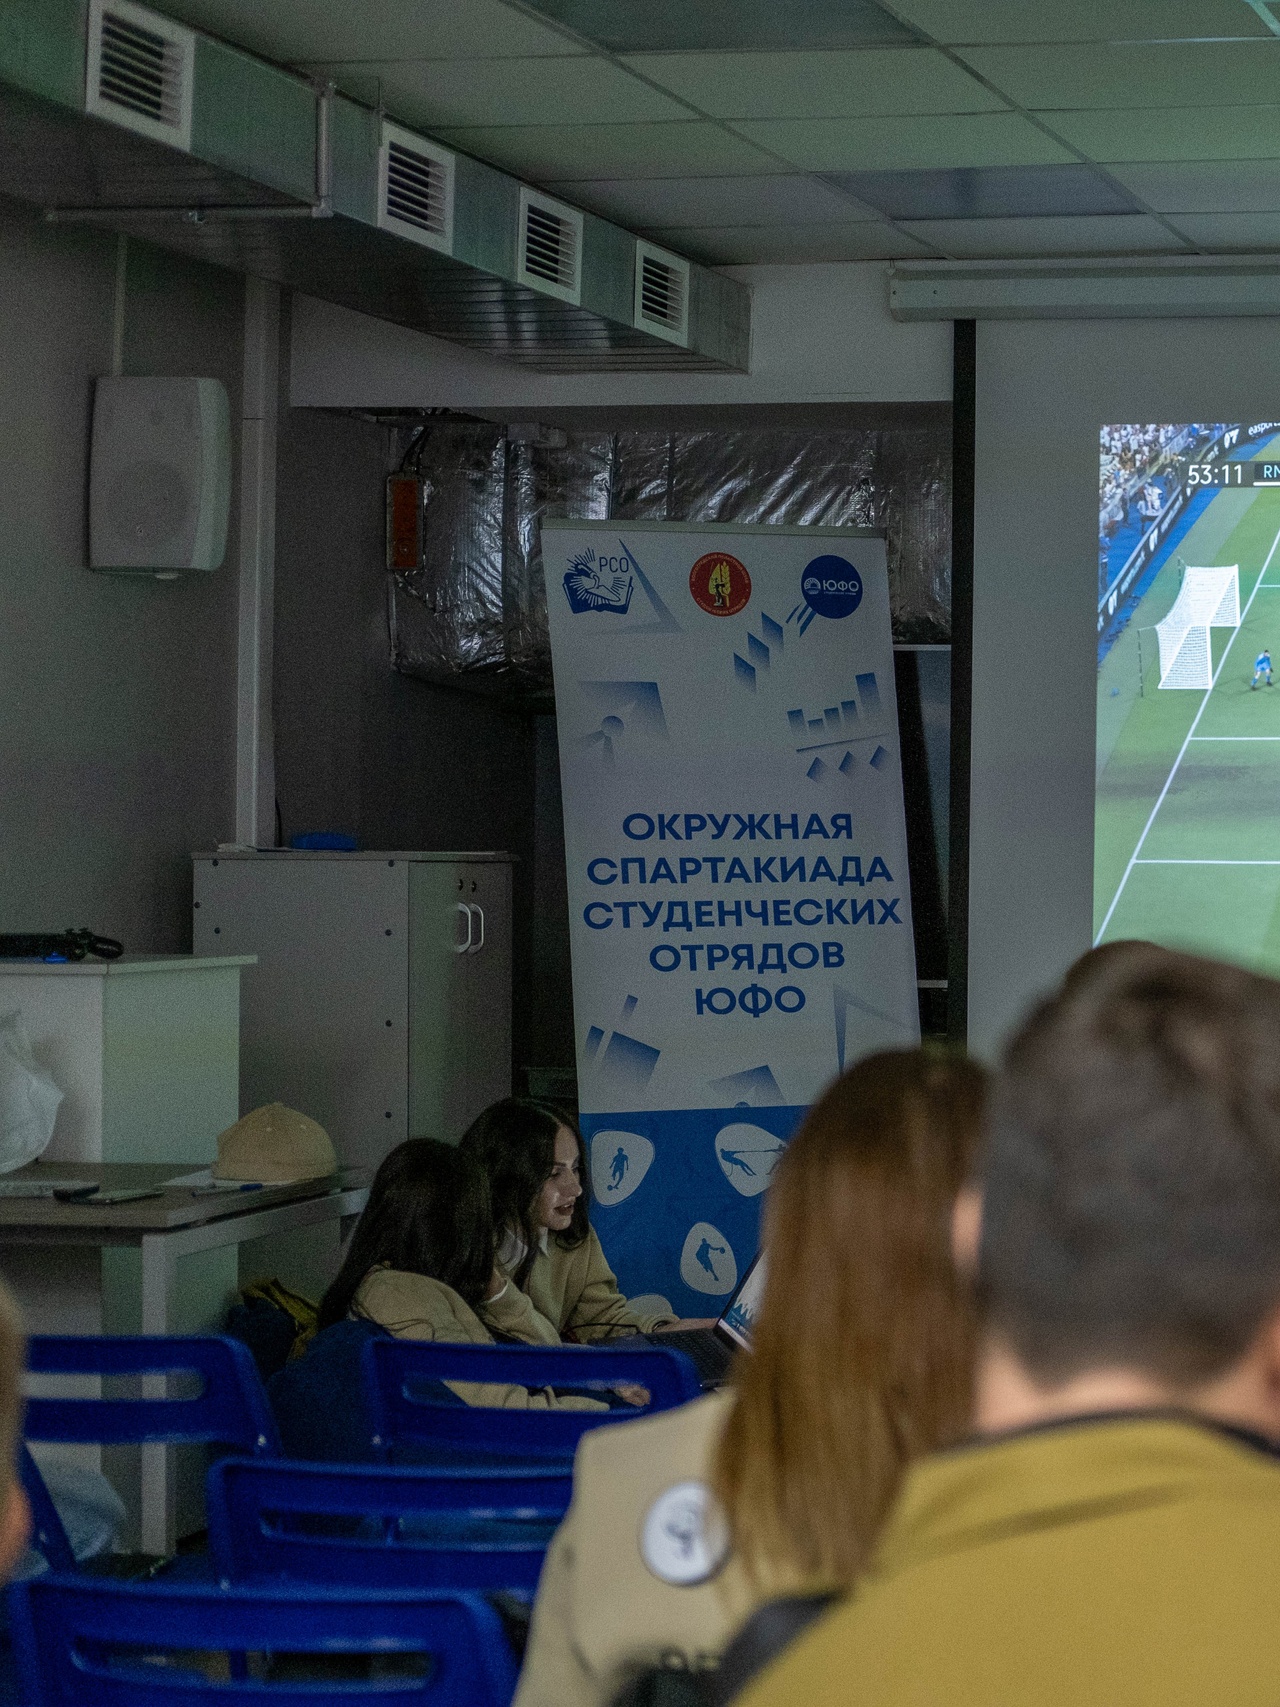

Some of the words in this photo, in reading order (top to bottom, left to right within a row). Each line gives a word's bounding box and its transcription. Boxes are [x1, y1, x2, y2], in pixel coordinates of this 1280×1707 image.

[1187, 463, 1243, 485] 53:11
[599, 556, 630, 573] РСО
[822, 579, 859, 592] ЮФО
[622, 812, 853, 840] ОКРУЖНАЯ
[587, 856, 895, 886] СПАРТАКИАДА
[583, 898, 903, 932] СТУДЕНЧЕСКИХ
[649, 941, 846, 974] ОТРЯДОВ
[695, 983, 806, 1018] ЮФО
